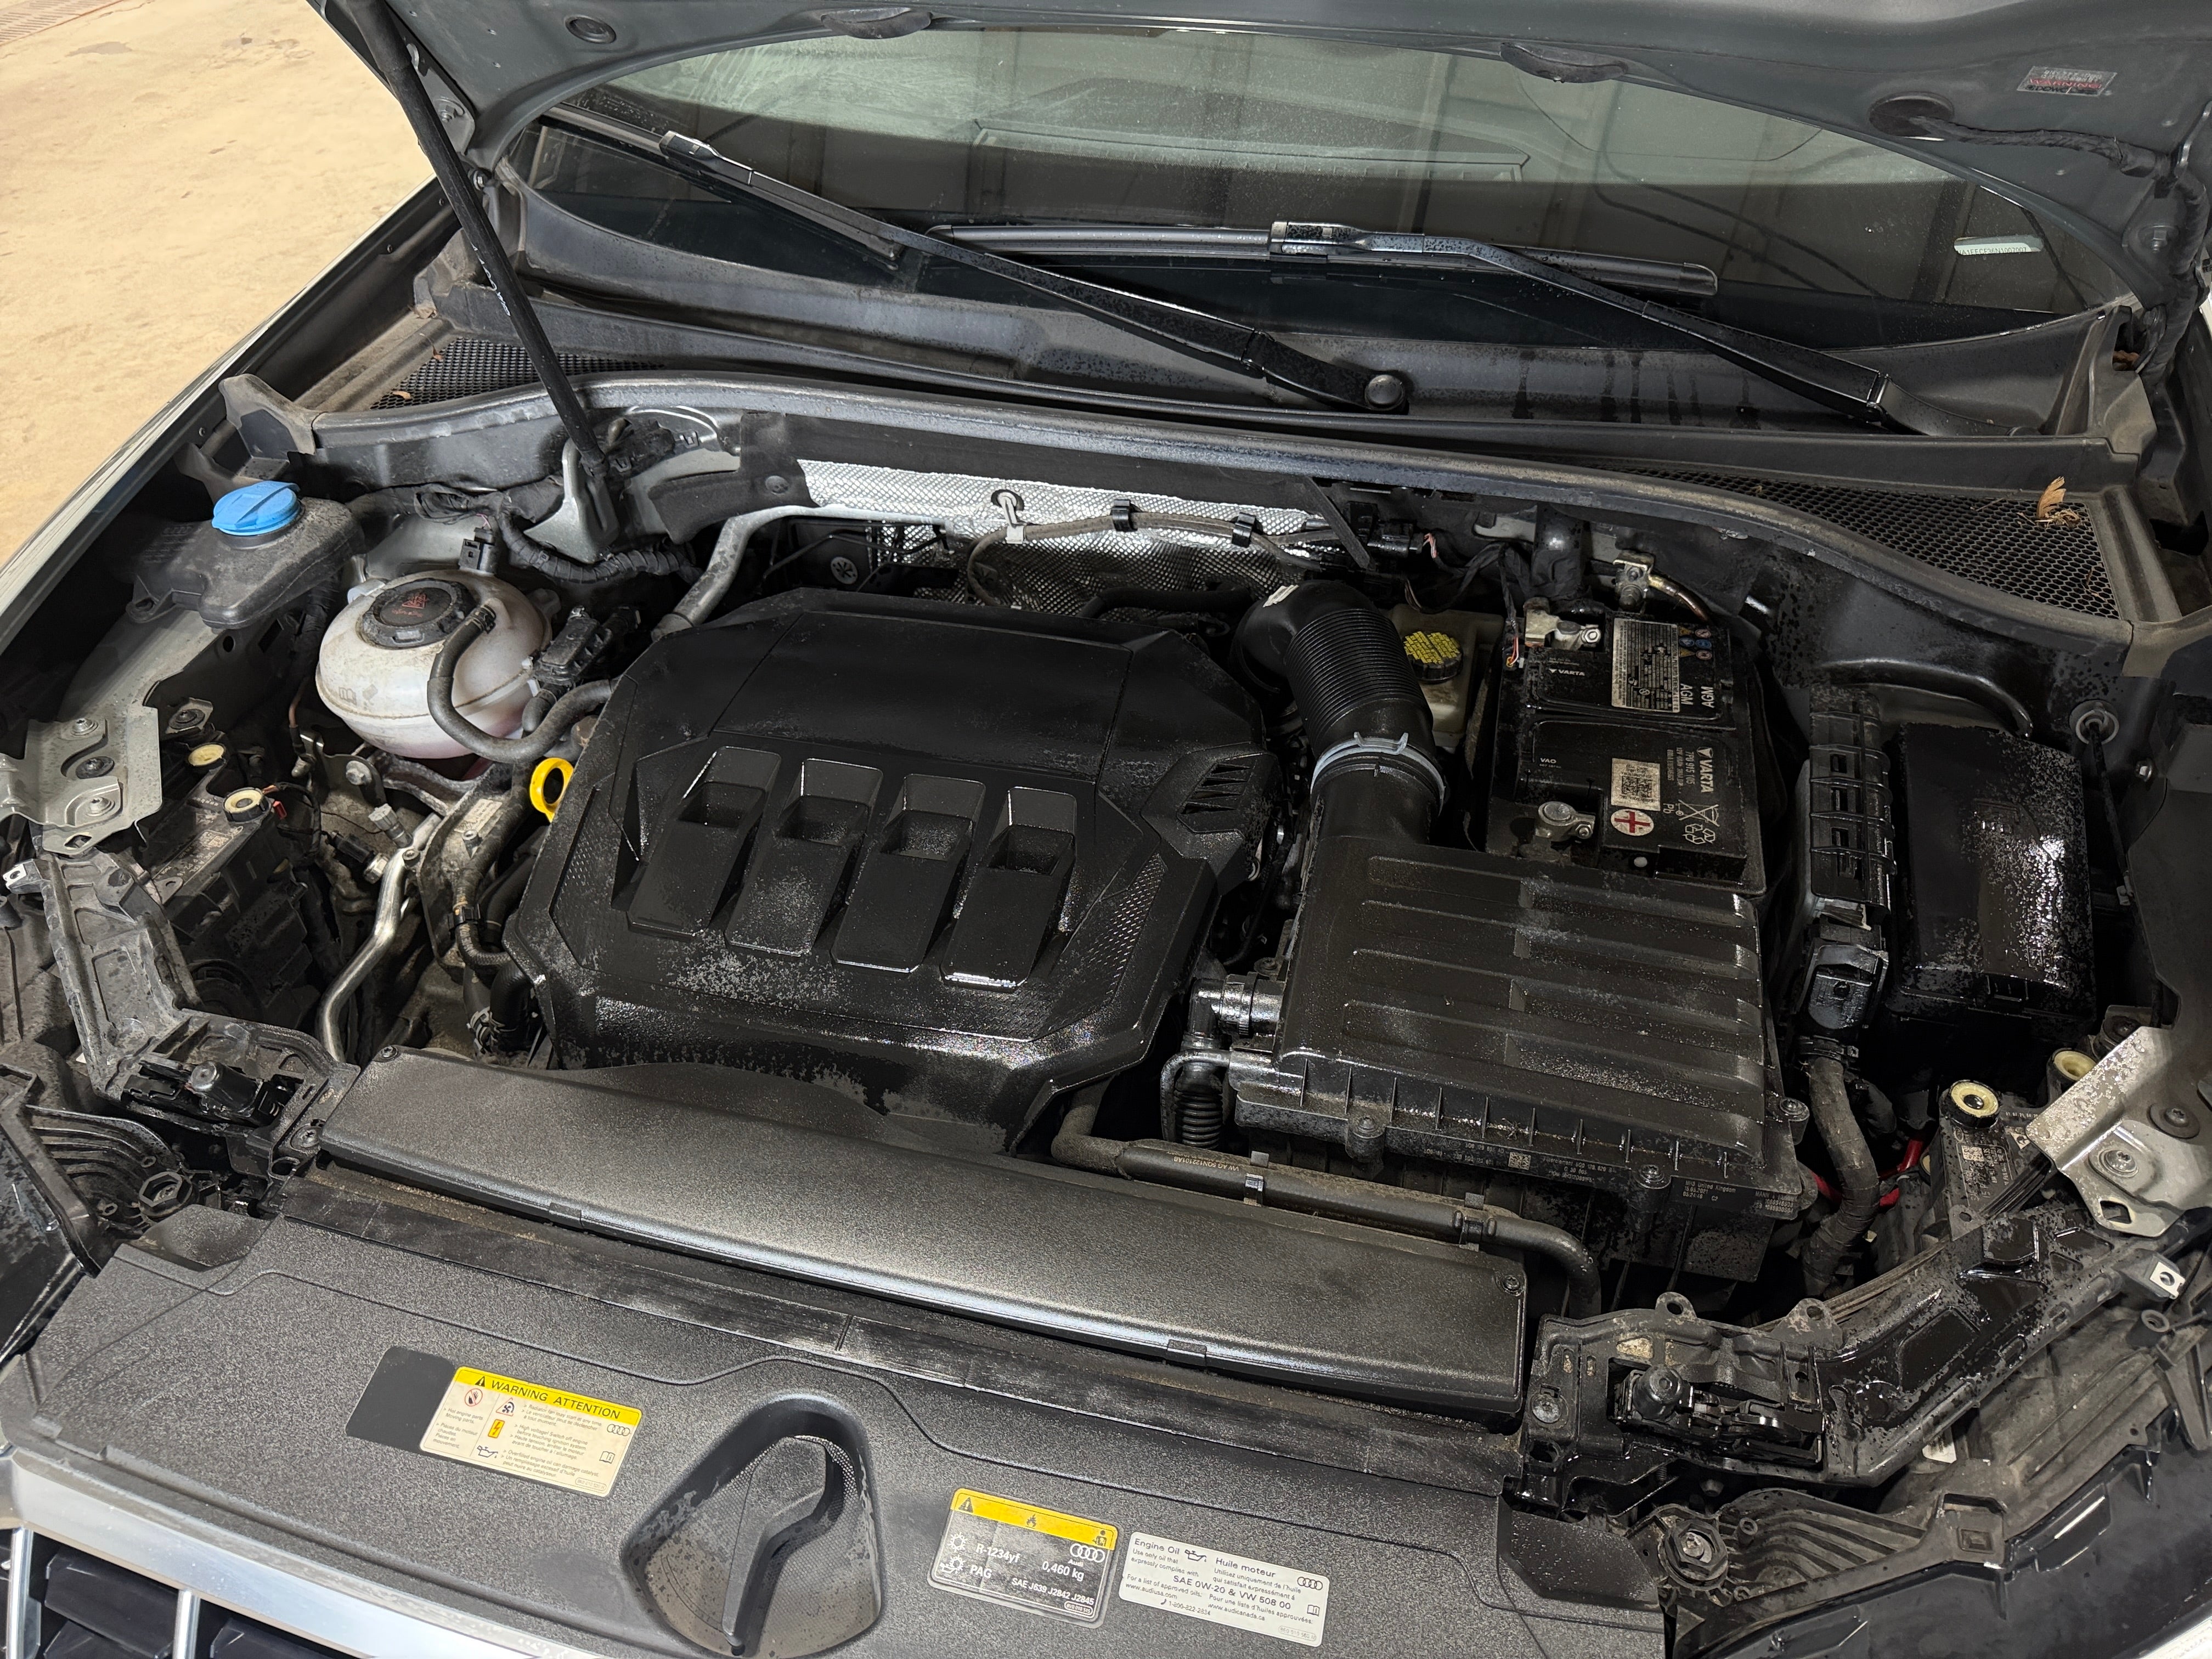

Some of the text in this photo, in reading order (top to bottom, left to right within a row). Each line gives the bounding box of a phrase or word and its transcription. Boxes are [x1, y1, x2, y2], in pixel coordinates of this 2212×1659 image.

[1680, 684, 1694, 706] AGM
[1701, 686, 1715, 708] AGM
[1685, 763, 1695, 774] 915
[1700, 759, 1714, 793] VARTA
[1663, 803, 1674, 814] Pb
[1697, 1181, 1714, 1190] United
[1715, 1184, 1736, 1194] Kingdom
[491, 1380, 620, 1419] WARNING ATTENTION
[445, 1413, 462, 1421] Moving
[532, 1434, 551, 1442] touching
[507, 1449, 530, 1459] Overfilled
[562, 1464, 580, 1472] damage
[513, 1457, 540, 1468] remplissage
[976, 1543, 1020, 1564] R-1234yf
[1133, 1538, 1180, 1555] Engine Oil
[1144, 1551, 1157, 1560] only
[970, 1564, 992, 1579] PAG
[1042, 1561, 1084, 1581] 0,460 kg
[1068, 1559, 1085, 1567] Audi
[1130, 1556, 1158, 1568] expressly
[1159, 1564, 1185, 1575] complies
[1215, 1557, 1276, 1578] Huile moteur
[1161, 1582, 1189, 1594] approved
[1214, 1567, 1235, 1577] Utilisez
[1237, 1573, 1272, 1587] uniquement
[1283, 1584, 1301, 1593] l'huile
[1223, 1578, 1246, 1588] satisfait
[1248, 1584, 1290, 1599] expressément
[1011, 1577, 1095, 1606] SAE J639 J2842 J2845
[1125, 1582, 1178, 1599] www.audiusa.com
[1172, 1575, 1291, 1610] SAE 0W-20 & VW 508 00
[1207, 1602, 1265, 1621] www.audicanada.ca
[1209, 1594, 1223, 1602] Pour
[1251, 1604, 1274, 1615] d'huiles
